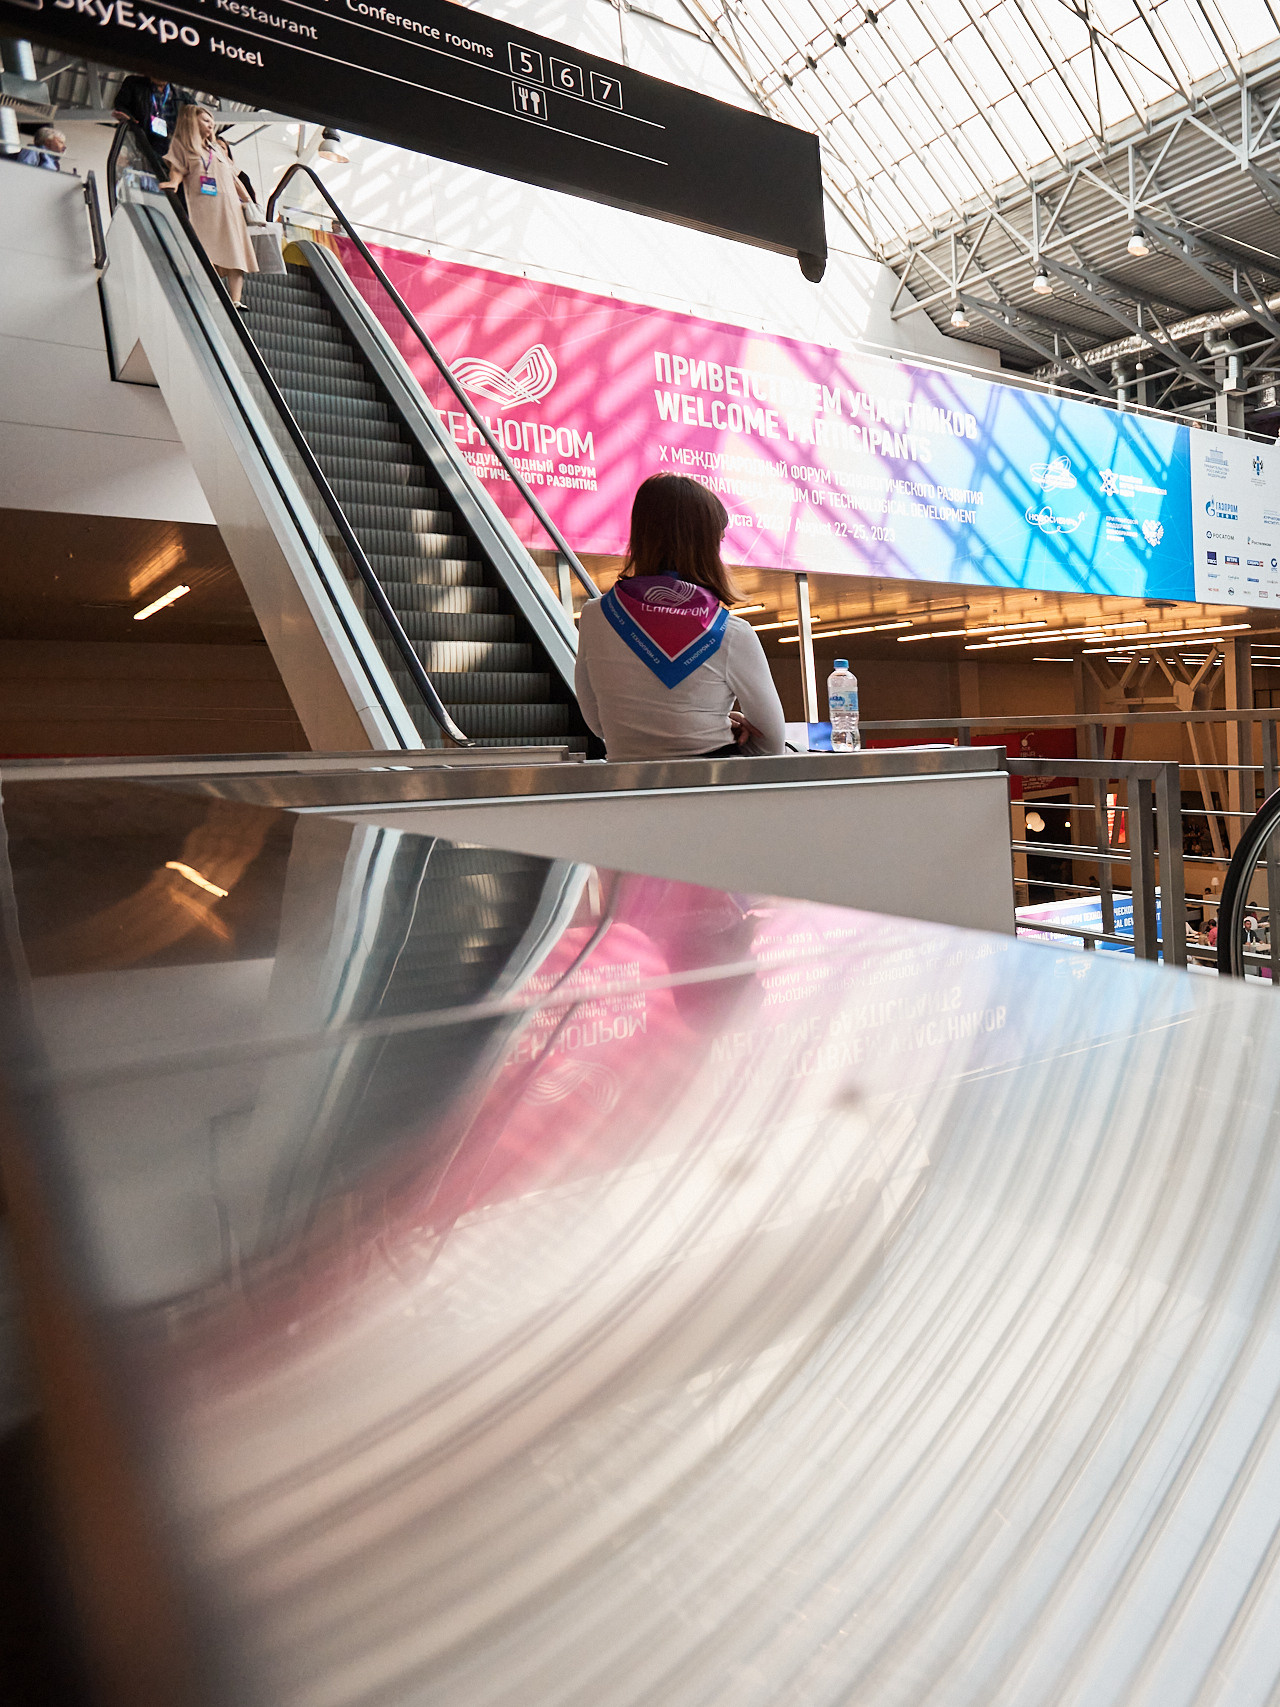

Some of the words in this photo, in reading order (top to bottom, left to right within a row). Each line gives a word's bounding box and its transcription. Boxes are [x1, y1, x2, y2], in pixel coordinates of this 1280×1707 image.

[216, 0, 318, 40] Restaurant
[347, 0, 440, 40] Conference
[445, 32, 494, 58] rooms
[210, 37, 264, 67] Hotel
[520, 52, 533, 74] 5
[560, 68, 574, 88] 6
[600, 80, 613, 100] 7
[654, 351, 842, 416] ПРИВЕТСТВУЕМ
[848, 389, 978, 440] УЧАСТНИКОВ
[654, 389, 780, 440] WELCOME
[786, 410, 932, 464] PARTICIPANTS
[547, 476, 598, 492] РАЗВИТИЯ
[558, 463, 597, 479] ФОРУМ
[671, 446, 788, 479] МЕЖДУНАРОДНЫЙ
[790, 464, 831, 485] ФОРУМ
[833, 471, 935, 498] ТЕХНОЛОГИЧЕСКОГО
[937, 486, 985, 506] РАЗВИТИЯ
[811, 489, 826, 506] OF
[827, 491, 909, 517] TECHNOLOGICAL
[911, 502, 976, 525] DEVELOPMENT
[1216, 501, 1239, 513] ГАЗПРОМ
[728, 514, 753, 529] уста
[870, 525, 896, 542] 2023
[1213, 532, 1235, 541] РОСАТОМ
[630, 631, 661, 665] ТЕХНОПРОМ-23
[683, 637, 717, 666] ТЕХНОПРОМ-23
